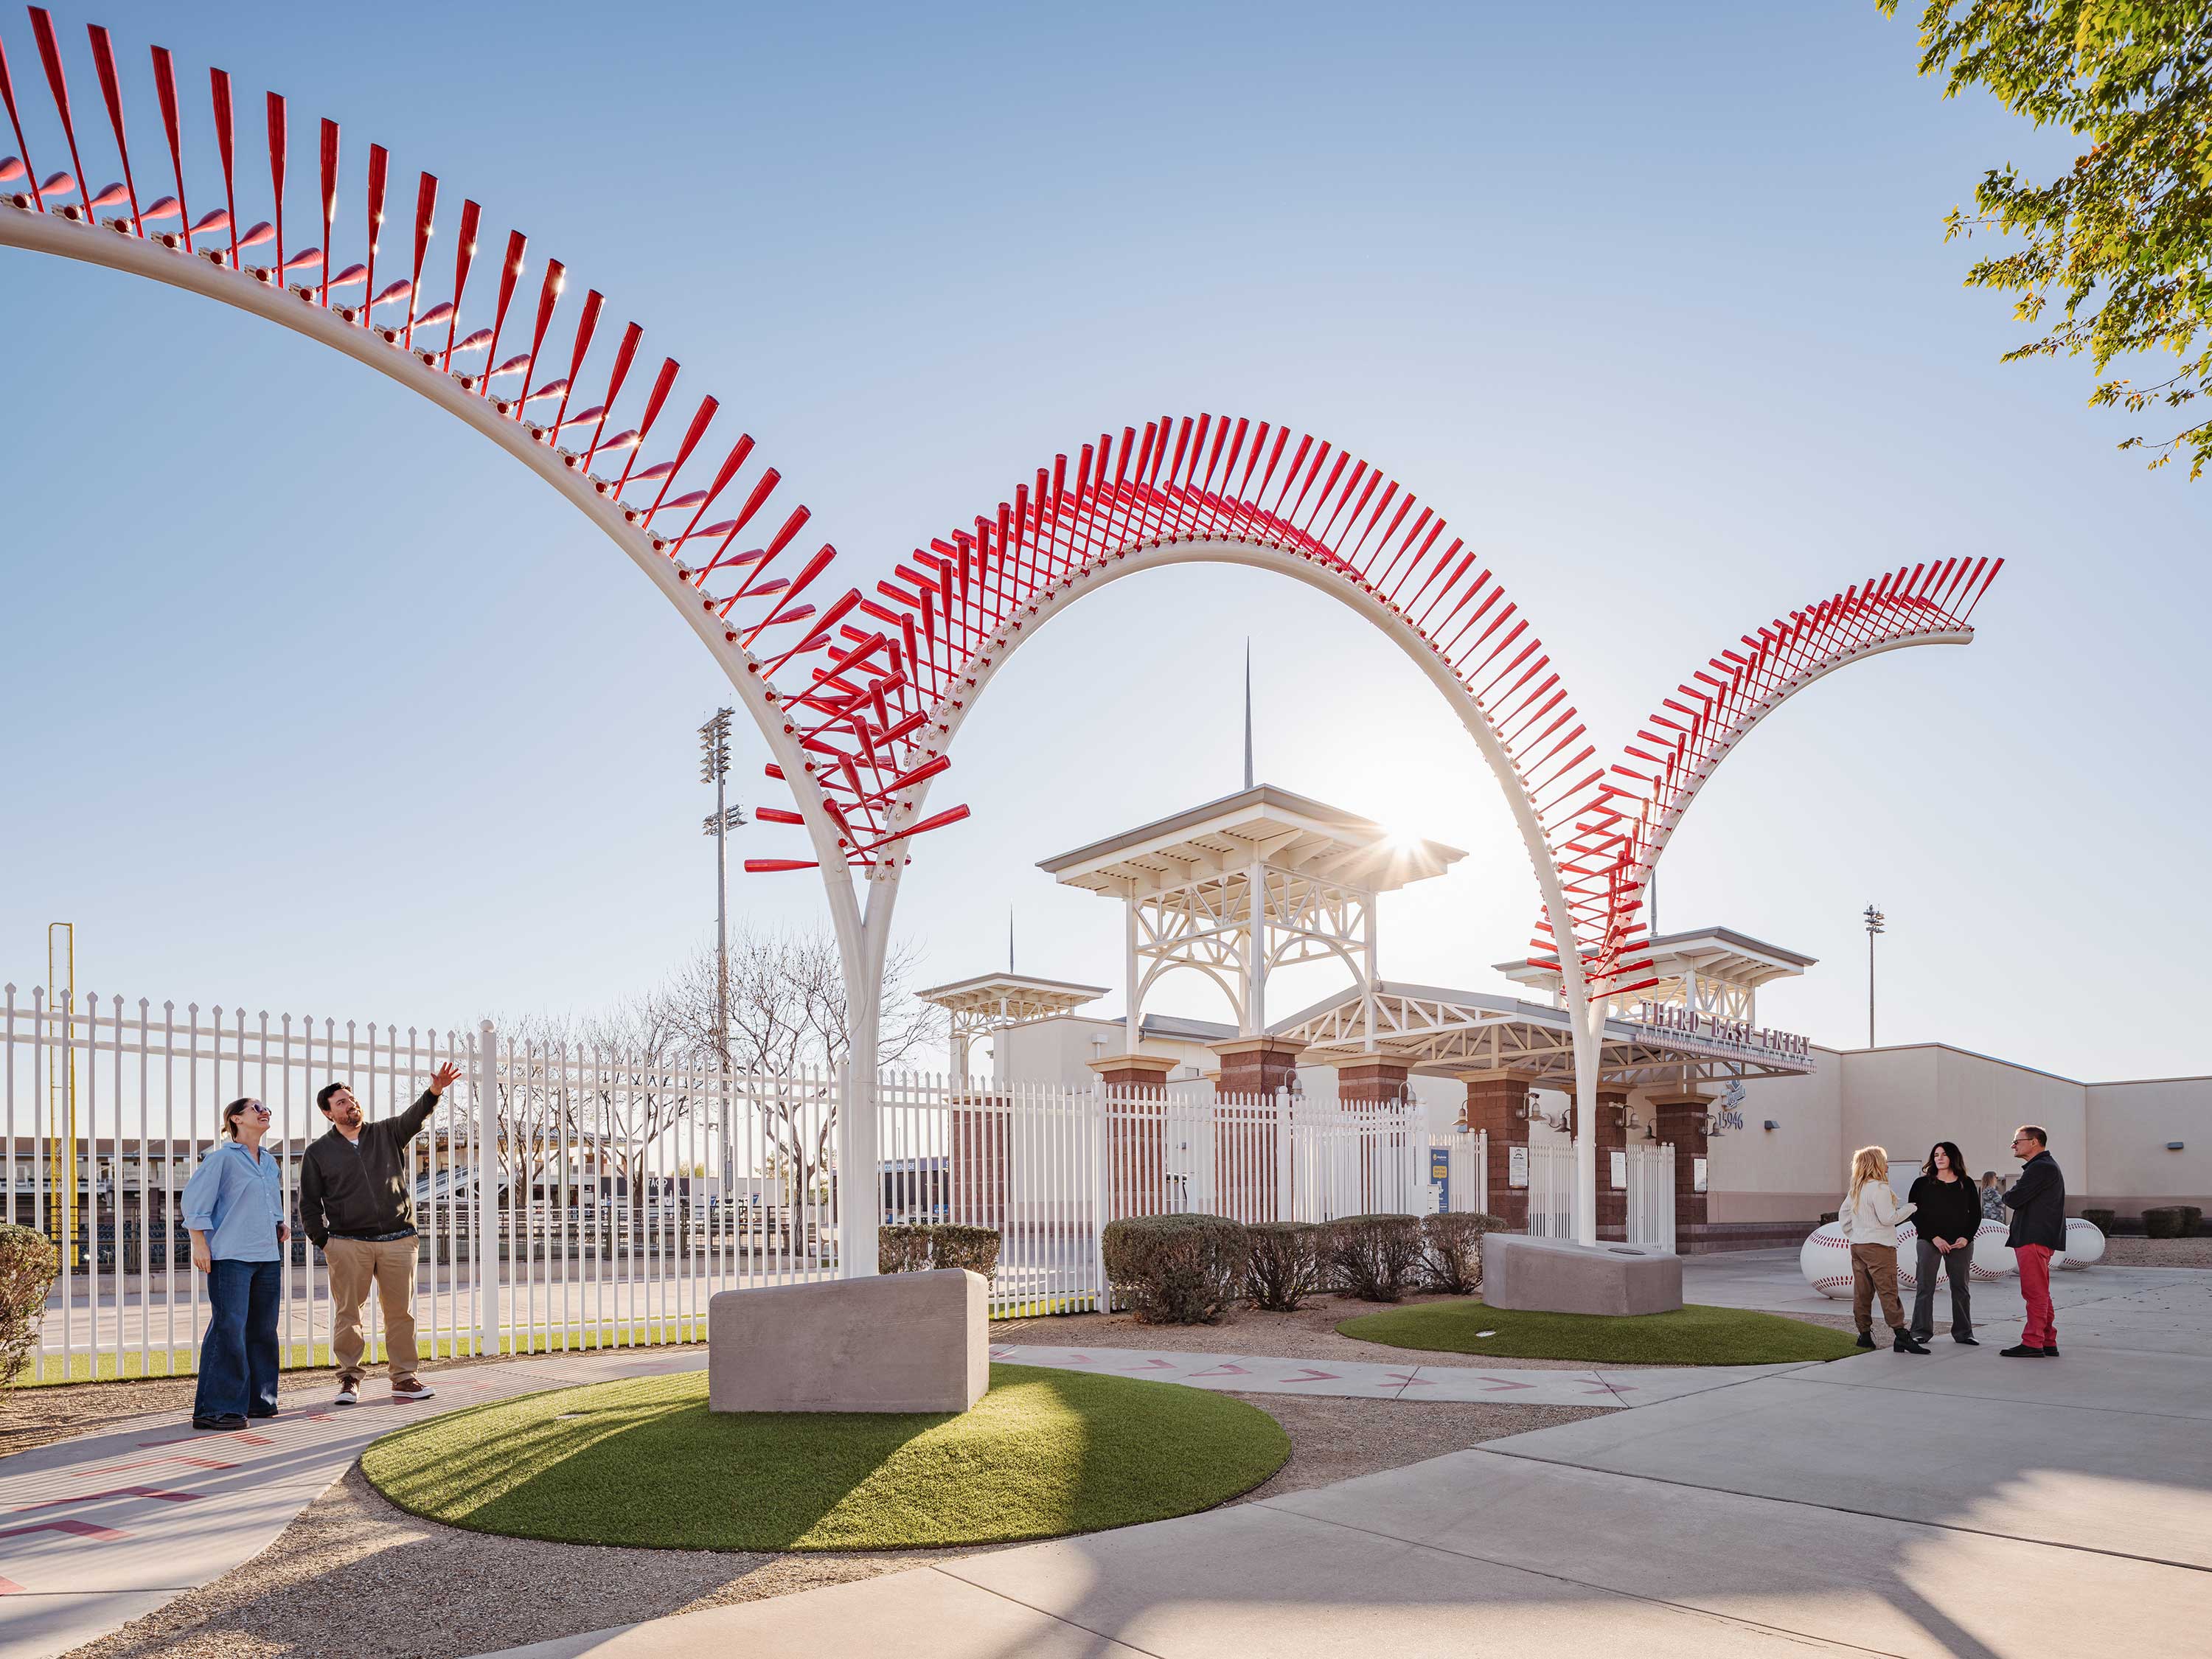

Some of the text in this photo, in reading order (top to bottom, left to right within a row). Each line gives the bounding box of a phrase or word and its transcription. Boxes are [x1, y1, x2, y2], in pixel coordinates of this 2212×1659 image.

[1639, 1000, 1811, 1055] THIRD BASE ENTRY
[1718, 1110, 1743, 1130] 15946
[884, 1163, 915, 1171] COCOUSE
